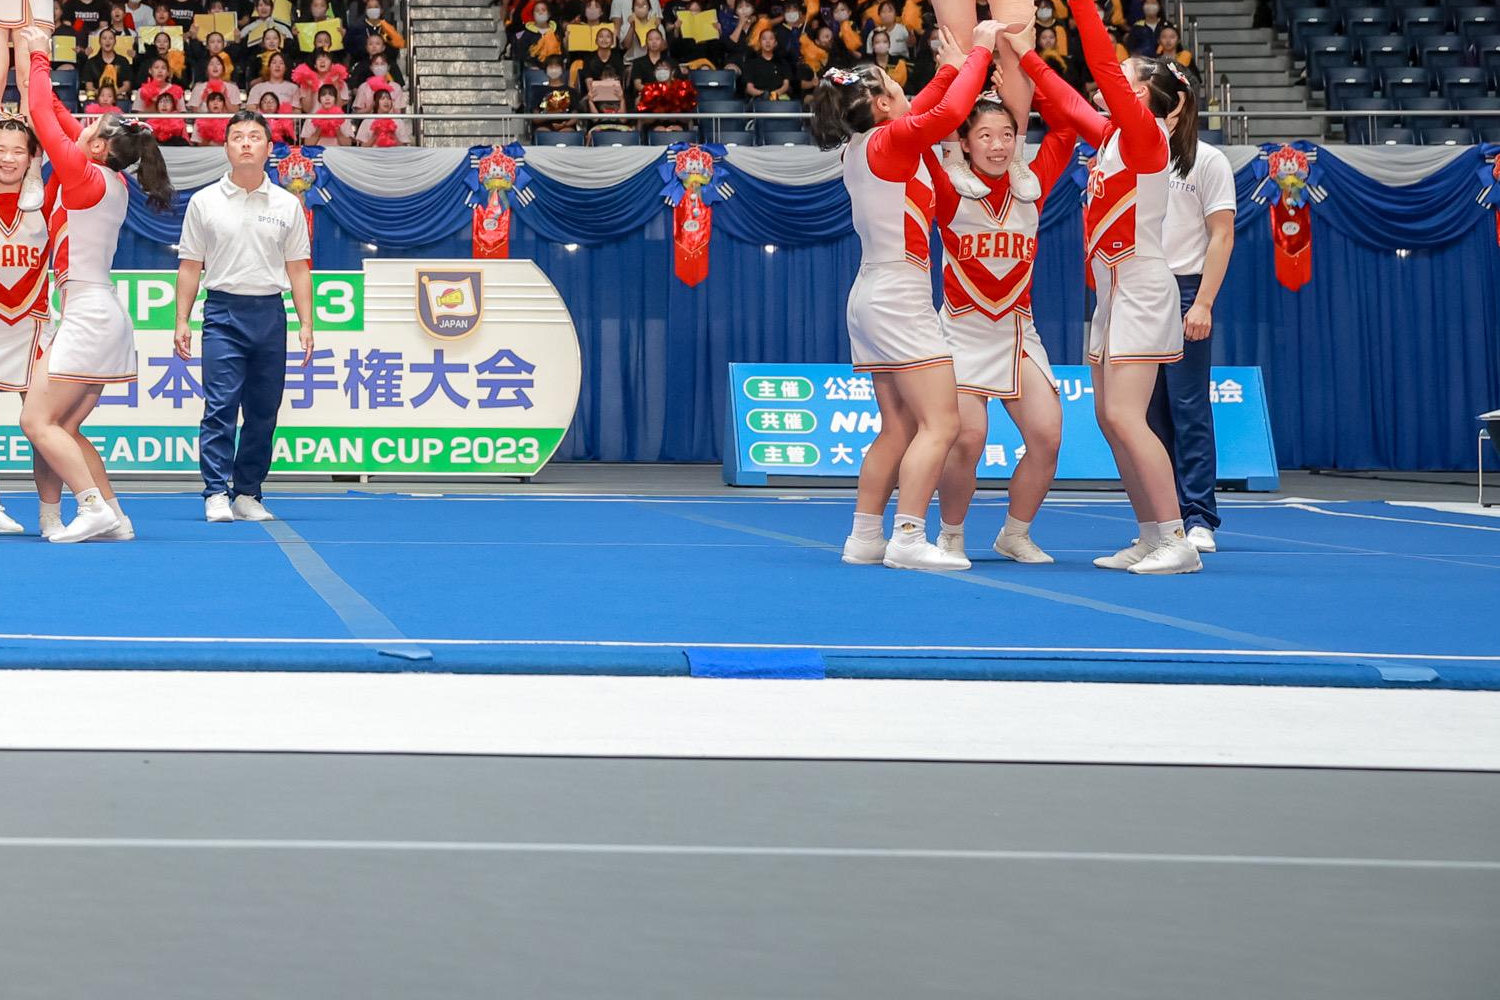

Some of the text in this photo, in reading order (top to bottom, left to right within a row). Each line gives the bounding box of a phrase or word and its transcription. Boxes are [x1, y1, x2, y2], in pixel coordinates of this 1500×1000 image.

[1169, 180, 1196, 193] OTTER
[258, 214, 287, 229] SPOTTER
[958, 231, 1035, 262] BEARS
[439, 319, 469, 329] JAPAN
[757, 380, 800, 398] 主催
[761, 411, 882, 433] 共催 NH
[272, 436, 539, 464] APAN CUP 2023
[763, 446, 805, 463] 主管
